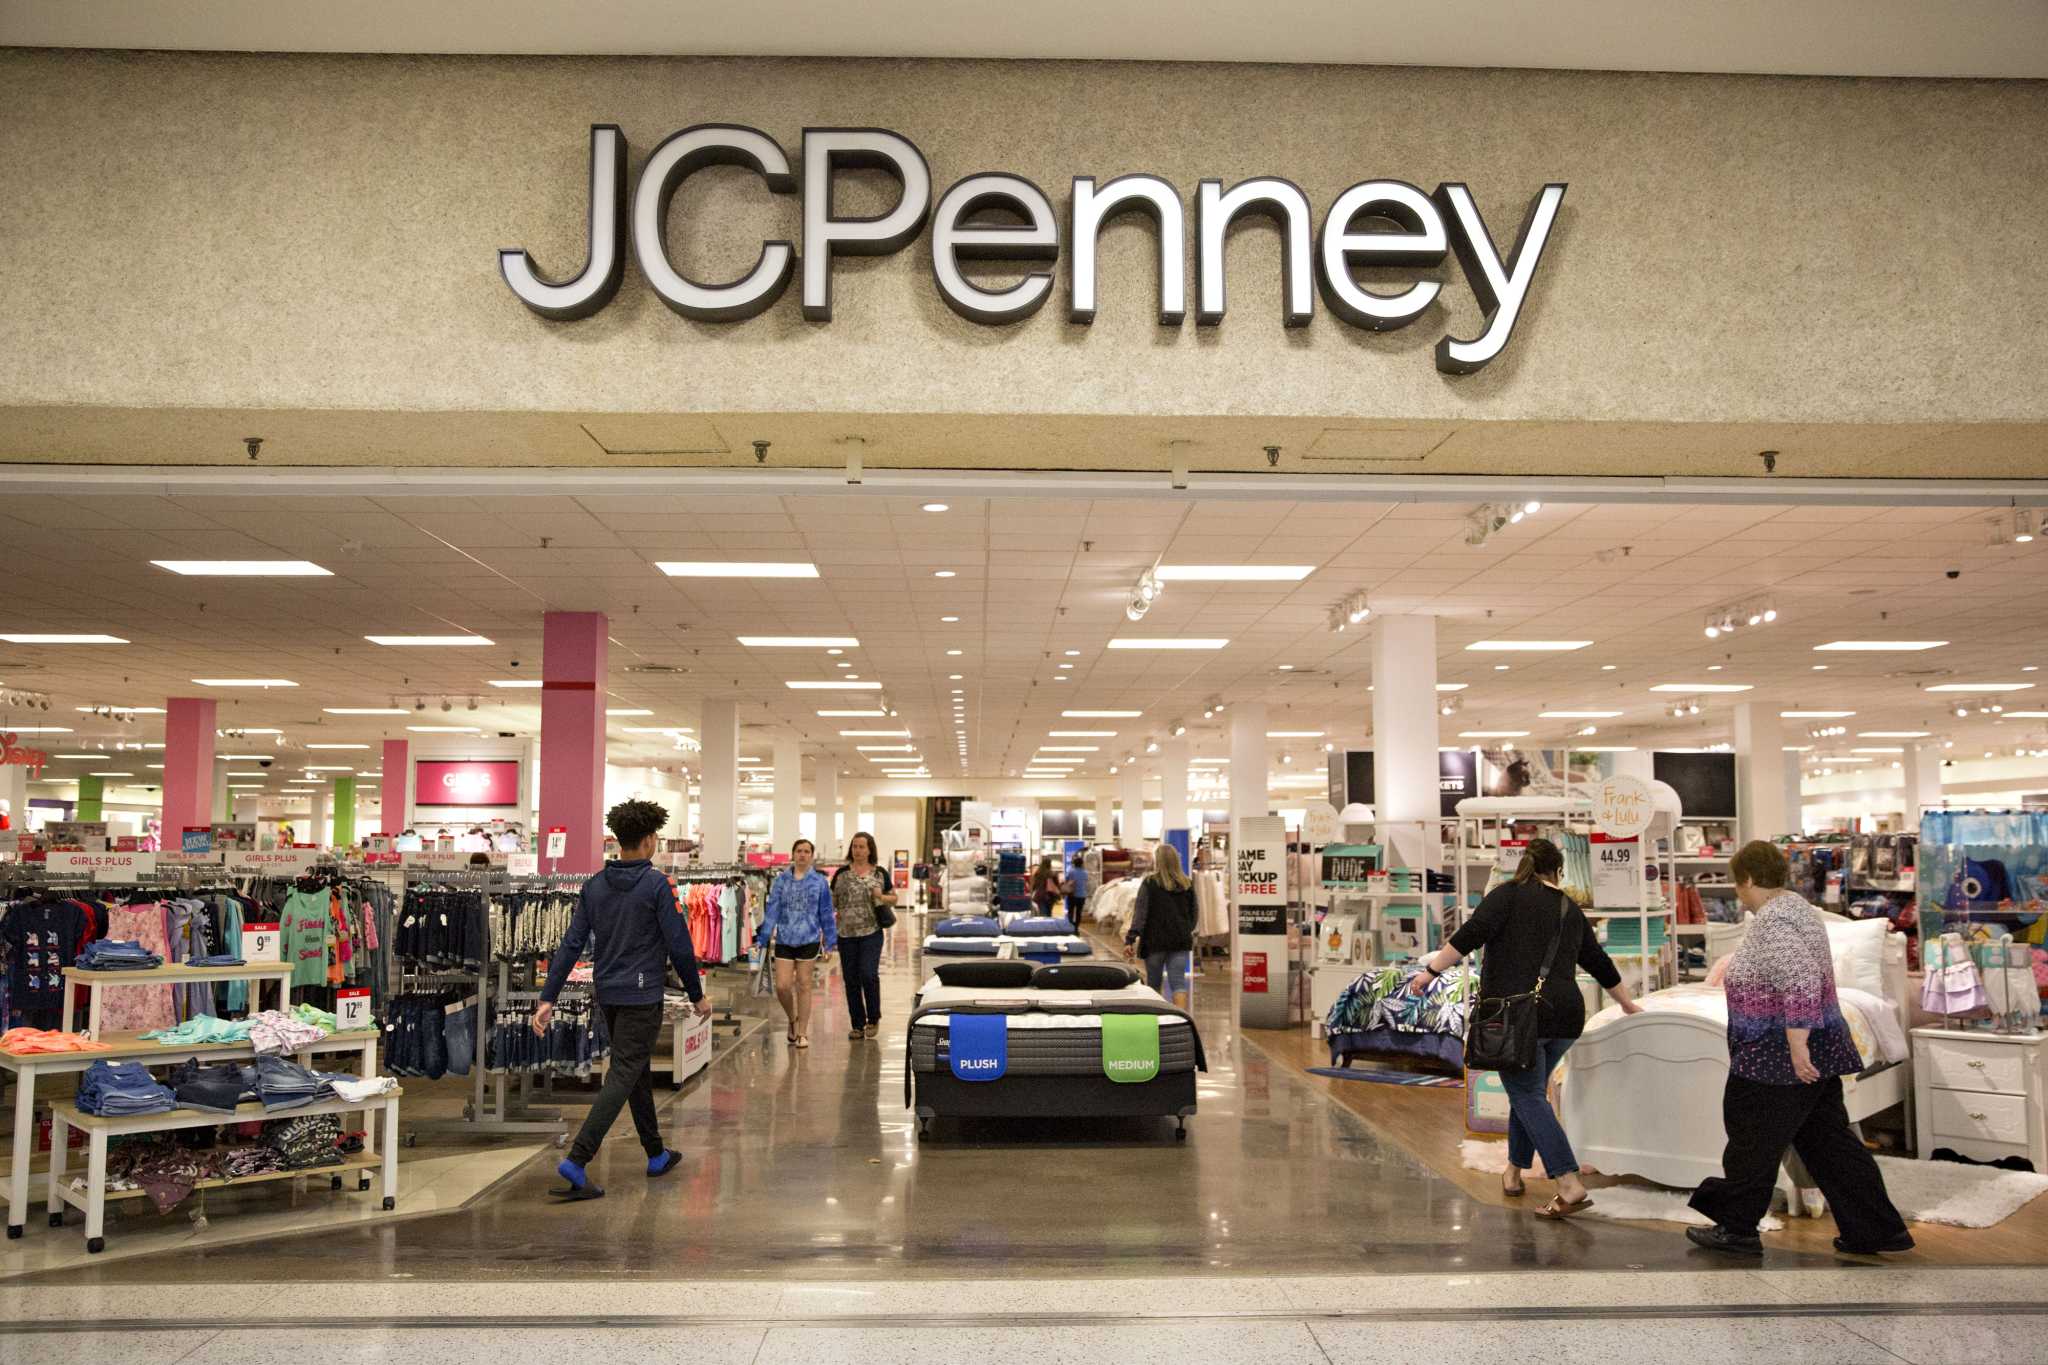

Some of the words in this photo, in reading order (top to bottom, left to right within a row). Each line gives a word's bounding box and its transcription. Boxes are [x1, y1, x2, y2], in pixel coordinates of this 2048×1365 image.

[498, 123, 1566, 374] JCPenney
[1604, 785, 1645, 806] Frank
[70, 856, 102, 866] GIRLS
[105, 856, 132, 866] PLUS
[245, 854, 272, 863] GIRLS
[274, 854, 297, 862] PLUS
[1600, 849, 1630, 862] 44.99
[1238, 861, 1253, 871] AY
[1331, 859, 1365, 881] DUDE
[1244, 884, 1277, 894] FREE
[959, 1058, 998, 1070] PLUSH
[1108, 1059, 1155, 1070] MEDIUM
